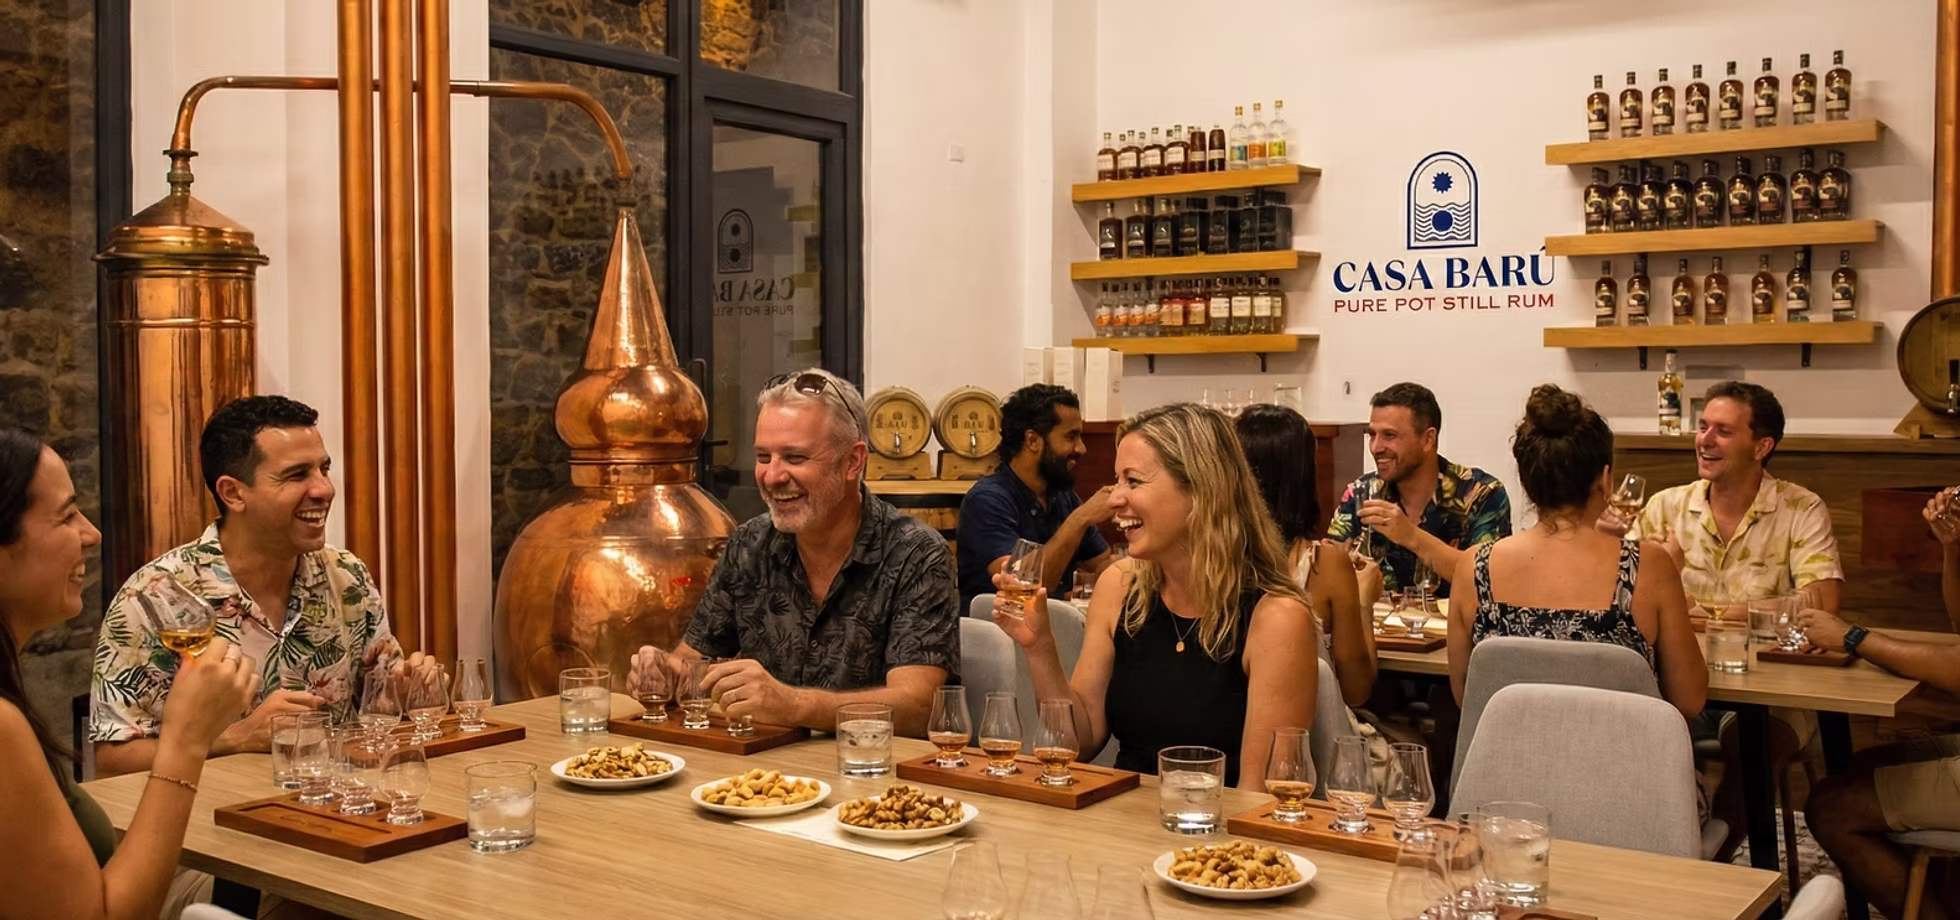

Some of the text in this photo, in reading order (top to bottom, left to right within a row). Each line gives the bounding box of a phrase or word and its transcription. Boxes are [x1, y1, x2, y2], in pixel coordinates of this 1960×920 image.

[1333, 258, 1433, 293] CASA
[1334, 293, 1555, 313] PURE POT STILL RUM
